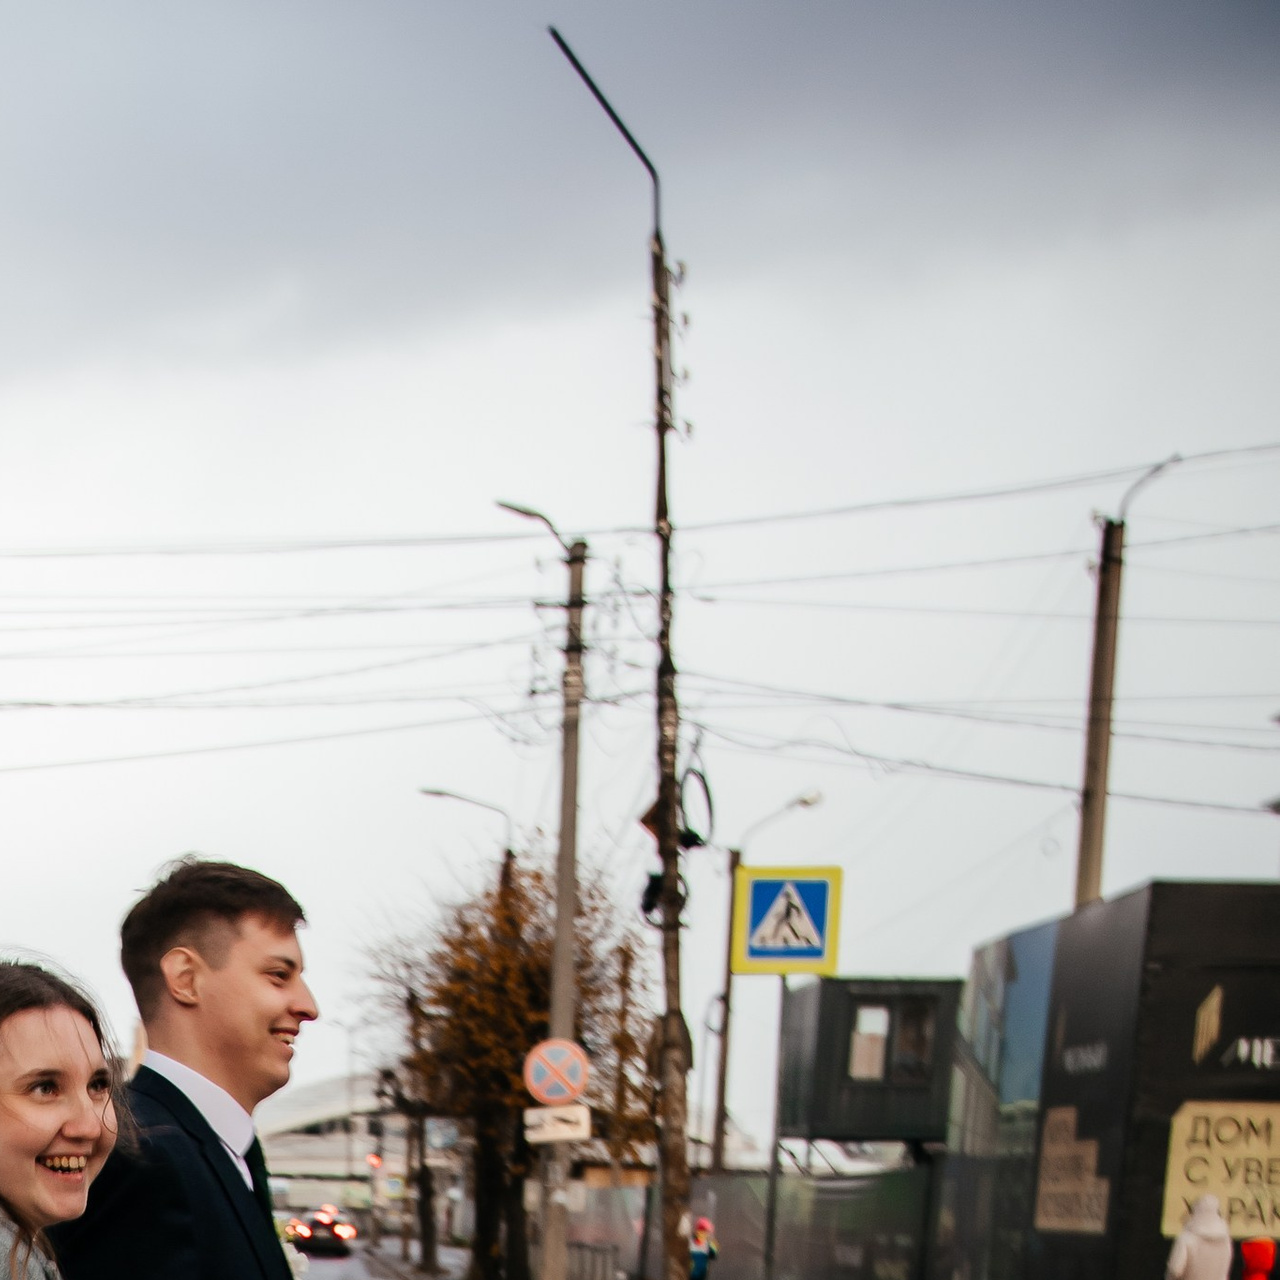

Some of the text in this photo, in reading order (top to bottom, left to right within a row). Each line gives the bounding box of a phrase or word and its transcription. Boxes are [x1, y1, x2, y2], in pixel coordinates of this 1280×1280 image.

[1186, 1115, 1272, 1150] ДОМ
[1183, 1156, 1280, 1187] С УВЕ
